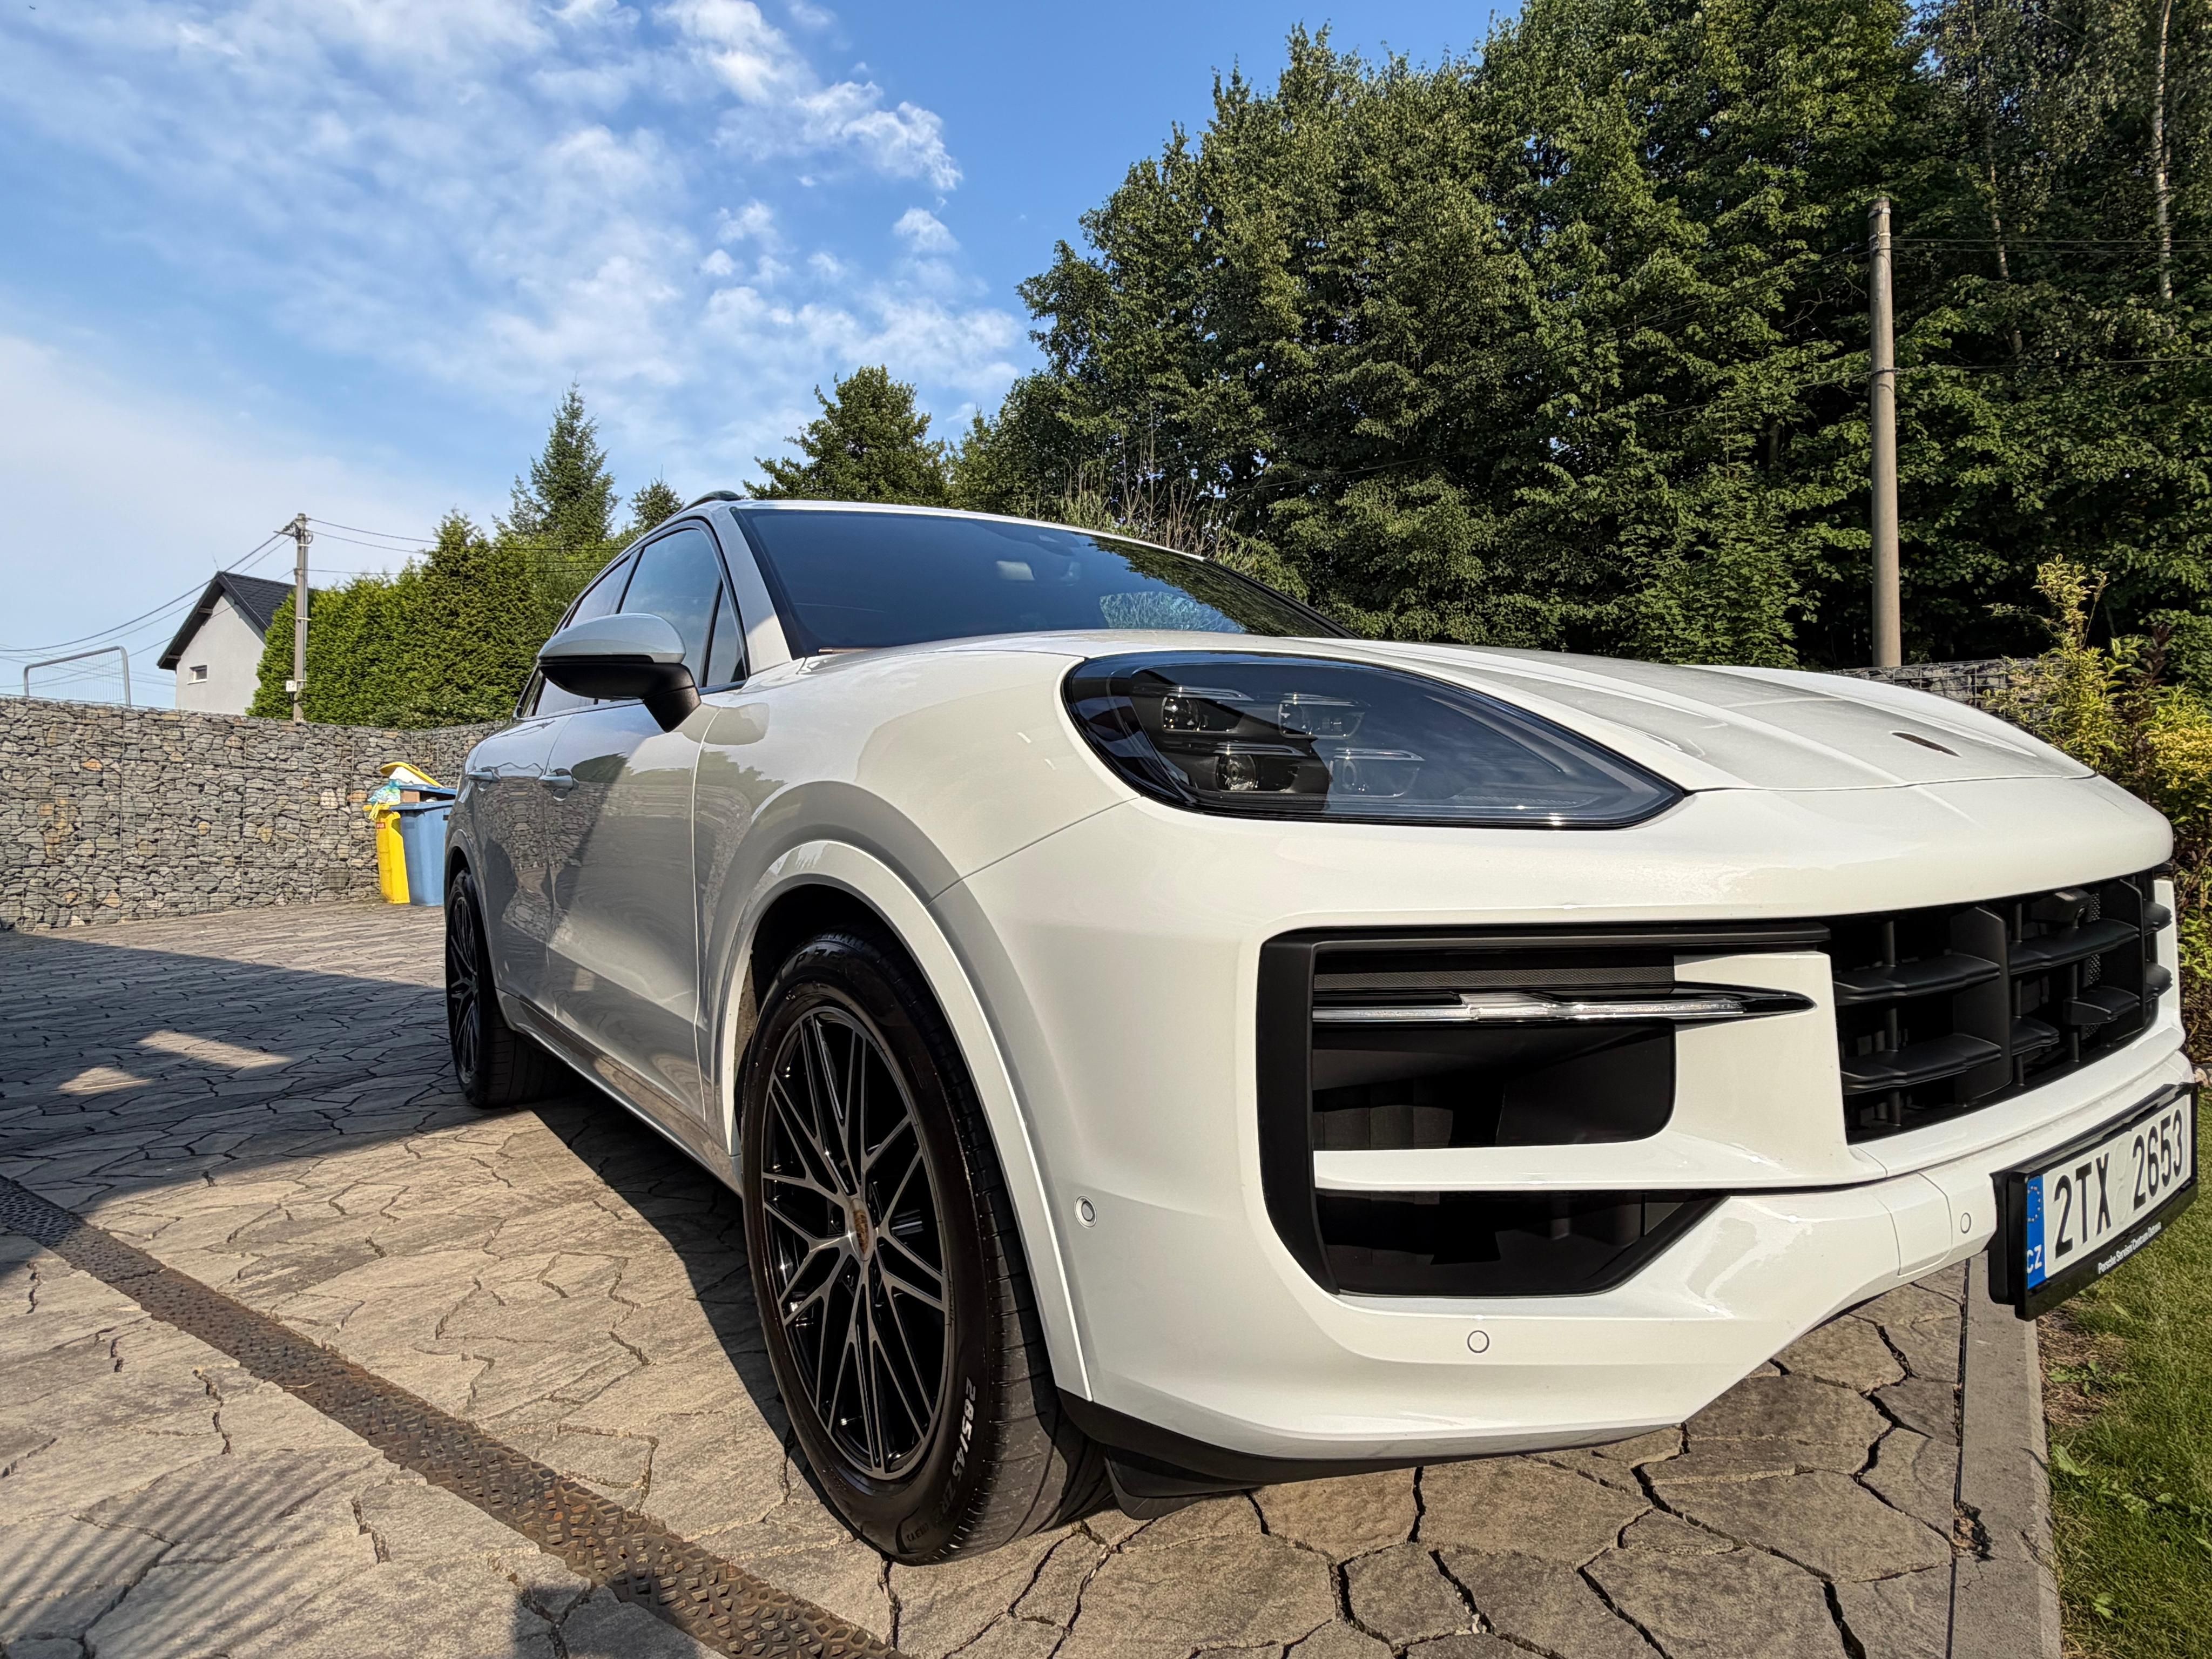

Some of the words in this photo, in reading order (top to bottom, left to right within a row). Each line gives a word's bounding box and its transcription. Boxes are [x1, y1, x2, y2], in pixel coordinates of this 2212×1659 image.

[2054, 1152, 2112, 1259] 2TX
[2132, 1109, 2182, 1211] 2653
[2026, 1244, 2042, 1273] CZ
[952, 1377, 976, 1482] 285/45
